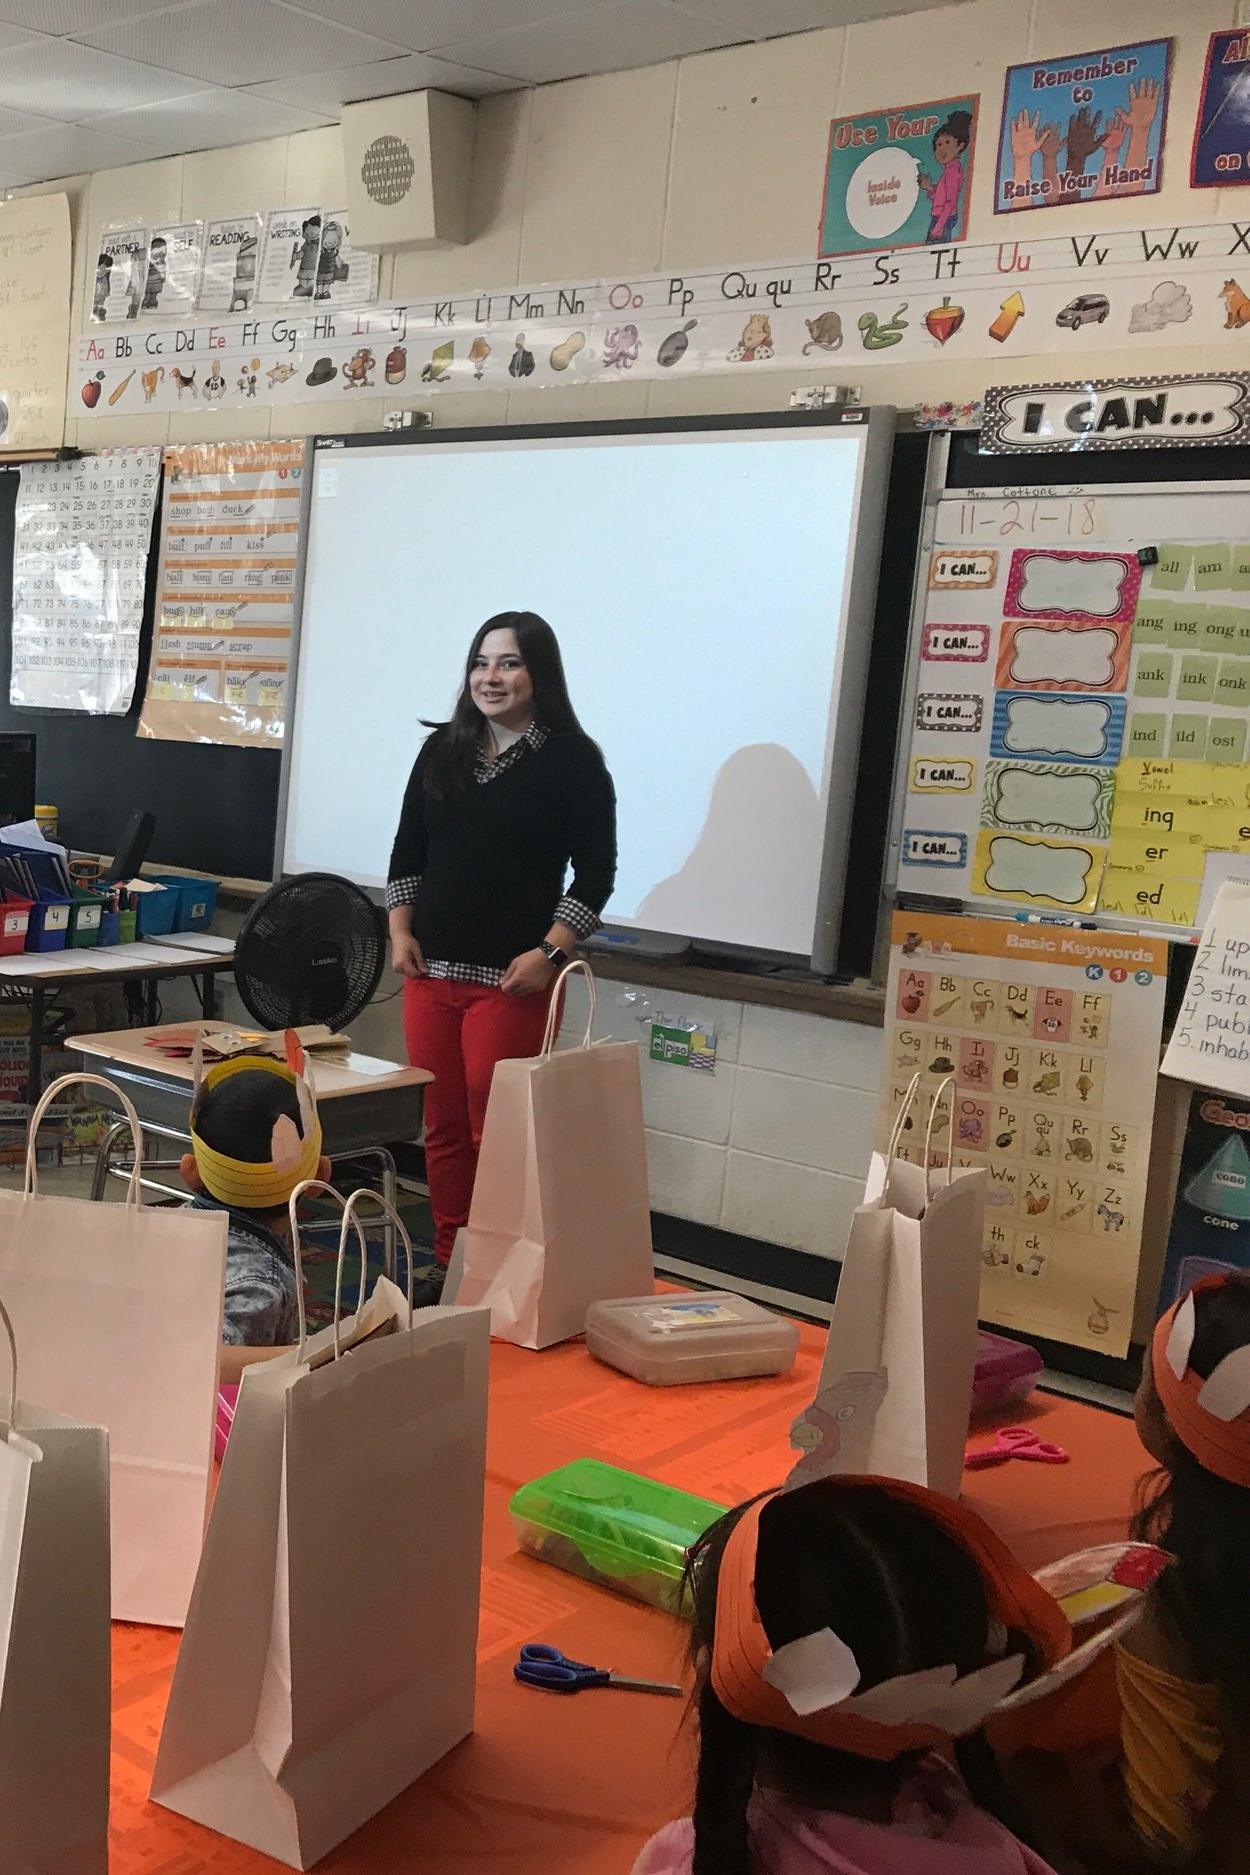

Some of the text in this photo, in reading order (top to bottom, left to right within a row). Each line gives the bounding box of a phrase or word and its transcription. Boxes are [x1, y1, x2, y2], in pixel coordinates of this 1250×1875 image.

[1032, 55, 1139, 90] Remember
[1072, 85, 1094, 105] to
[836, 114, 940, 151] Use Your
[1215, 153, 1241, 171] on
[867, 178, 902, 195] Inside
[1003, 158, 1155, 201] Raise Your Hand
[868, 192, 899, 208] Voice
[209, 231, 250, 246] READING
[271, 227, 301, 239] WRITING
[105, 241, 141, 256] PARTNER
[86, 340, 105, 361] Aa
[115, 335, 133, 358] Bb
[145, 333, 163, 355] Cc
[175, 330, 195, 352] Dd
[208, 326, 226, 350] Ee
[242, 322, 259, 346] Ff
[271, 319, 298, 352] Gg
[313, 316, 336, 340] Hh
[509, 293, 544, 320] Mm
[557, 288, 585, 315] Nn
[609, 283, 644, 310] Oo
[668, 277, 695, 317] Pp
[721, 272, 758, 300] Qu
[766, 279, 792, 308] qu
[814, 262, 842, 291] Rr
[872, 255, 900, 286] Ss
[930, 248, 962, 279] Tt
[997, 242, 1032, 273] Uu
[1070, 234, 1114, 266] Vv
[1140, 227, 1200, 262] Ww
[1022, 392, 1216, 434] I CAN...
[170, 504, 244, 516] shop duck
[959, 498, 1096, 536] 11-21-18
[939, 562, 988, 577] I CAN...
[1161, 561, 1223, 574] all am
[1136, 616, 1236, 639] ang ing ong
[229, 641, 253, 652] scrap
[932, 636, 980, 650] I CAN...
[1137, 668, 1248, 690] ank ink onk
[926, 705, 973, 719] I CAN...
[1132, 729, 1236, 748] ind ild ost
[919, 768, 967, 783] I CAN...
[1141, 761, 1174, 776] Vowel
[1142, 807, 1175, 832] ing
[912, 840, 958, 856] I CAN...
[1145, 847, 1169, 862] er
[1136, 883, 1165, 905] ed
[11, 919, 19, 931] 3
[52, 911, 59, 923] 4
[84, 912, 92, 924] 5
[1204, 927, 1217, 949] 1
[1005, 933, 1155, 963] Basic Keywords
[1196, 950, 1211, 970] 2
[1088, 966, 1101, 978] K
[1138, 973, 1149, 983] 2
[906, 972, 1102, 1010] Aa Bb Cc Dd Ee Ff
[1191, 975, 1205, 997] 3
[1184, 1001, 1198, 1020] 4
[666, 1043, 688, 1057] piso
[900, 1030, 921, 1050] Gg
[934, 1035, 953, 1052] Hh
[1005, 1047, 1020, 1067] Jj
[1039, 1052, 1058, 1067] Kk
[961, 1100, 1128, 1143] Oo Pp Qu Rr Ss
[989, 1164, 1123, 1204] Ww Xx Yy Zz
[1202, 1214, 1240, 1232] cone
[990, 1225, 1040, 1250] th ck
